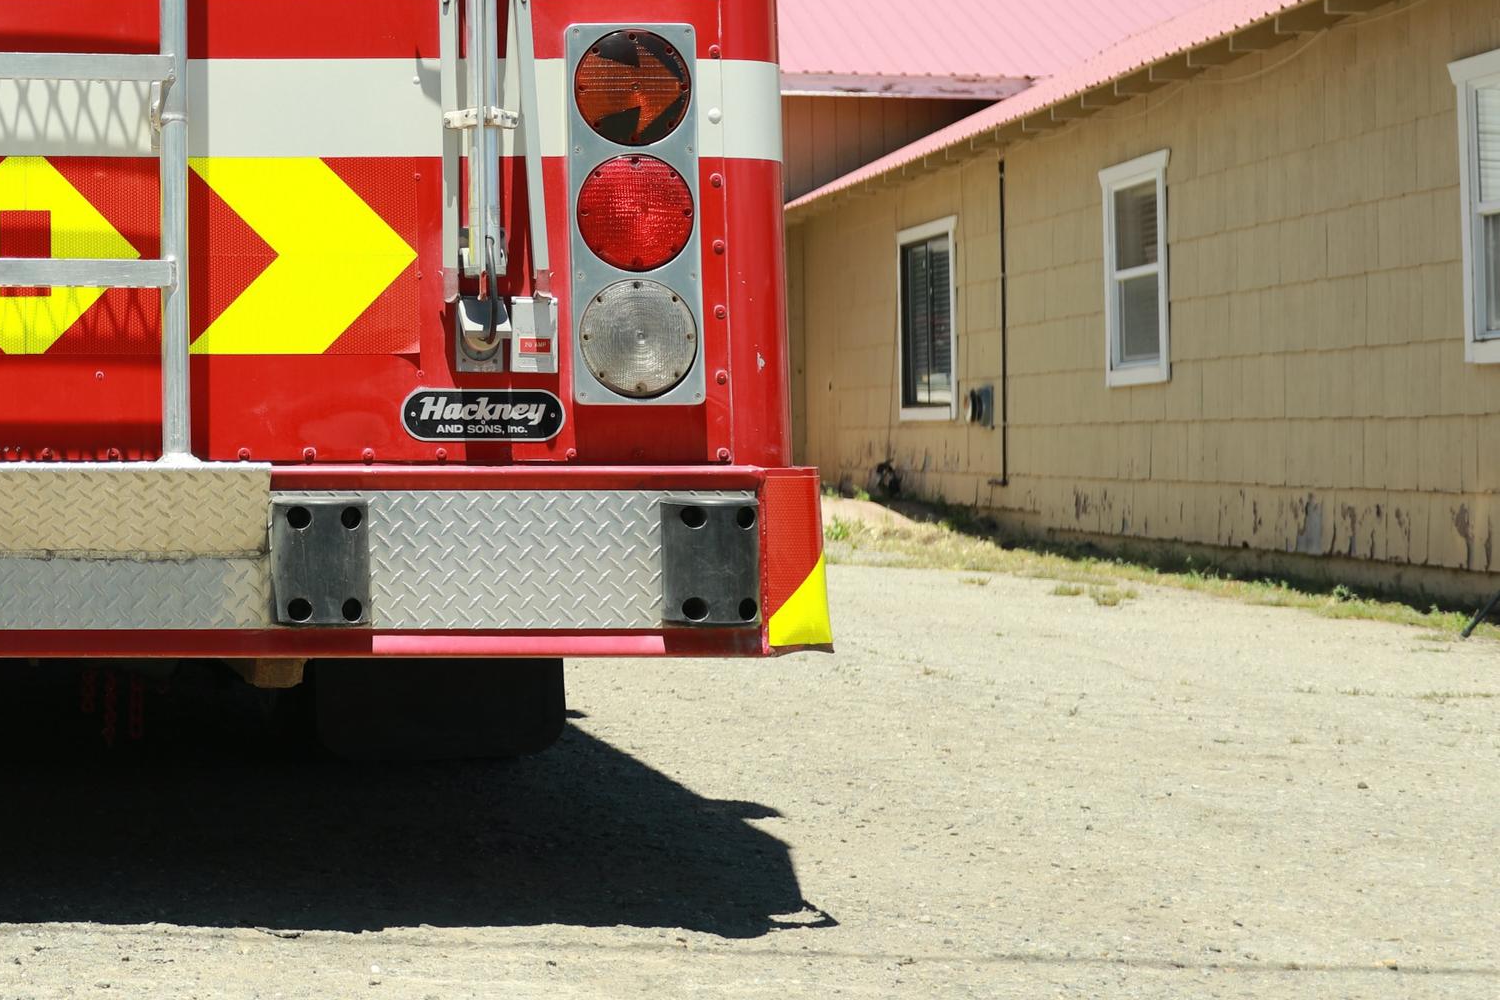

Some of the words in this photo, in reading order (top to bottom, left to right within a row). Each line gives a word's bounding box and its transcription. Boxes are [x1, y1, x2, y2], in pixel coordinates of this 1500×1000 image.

[419, 396, 546, 425] Hackney
[436, 424, 463, 433] AND
[467, 424, 505, 435] SONS,
[507, 424, 528, 433] Inc.
